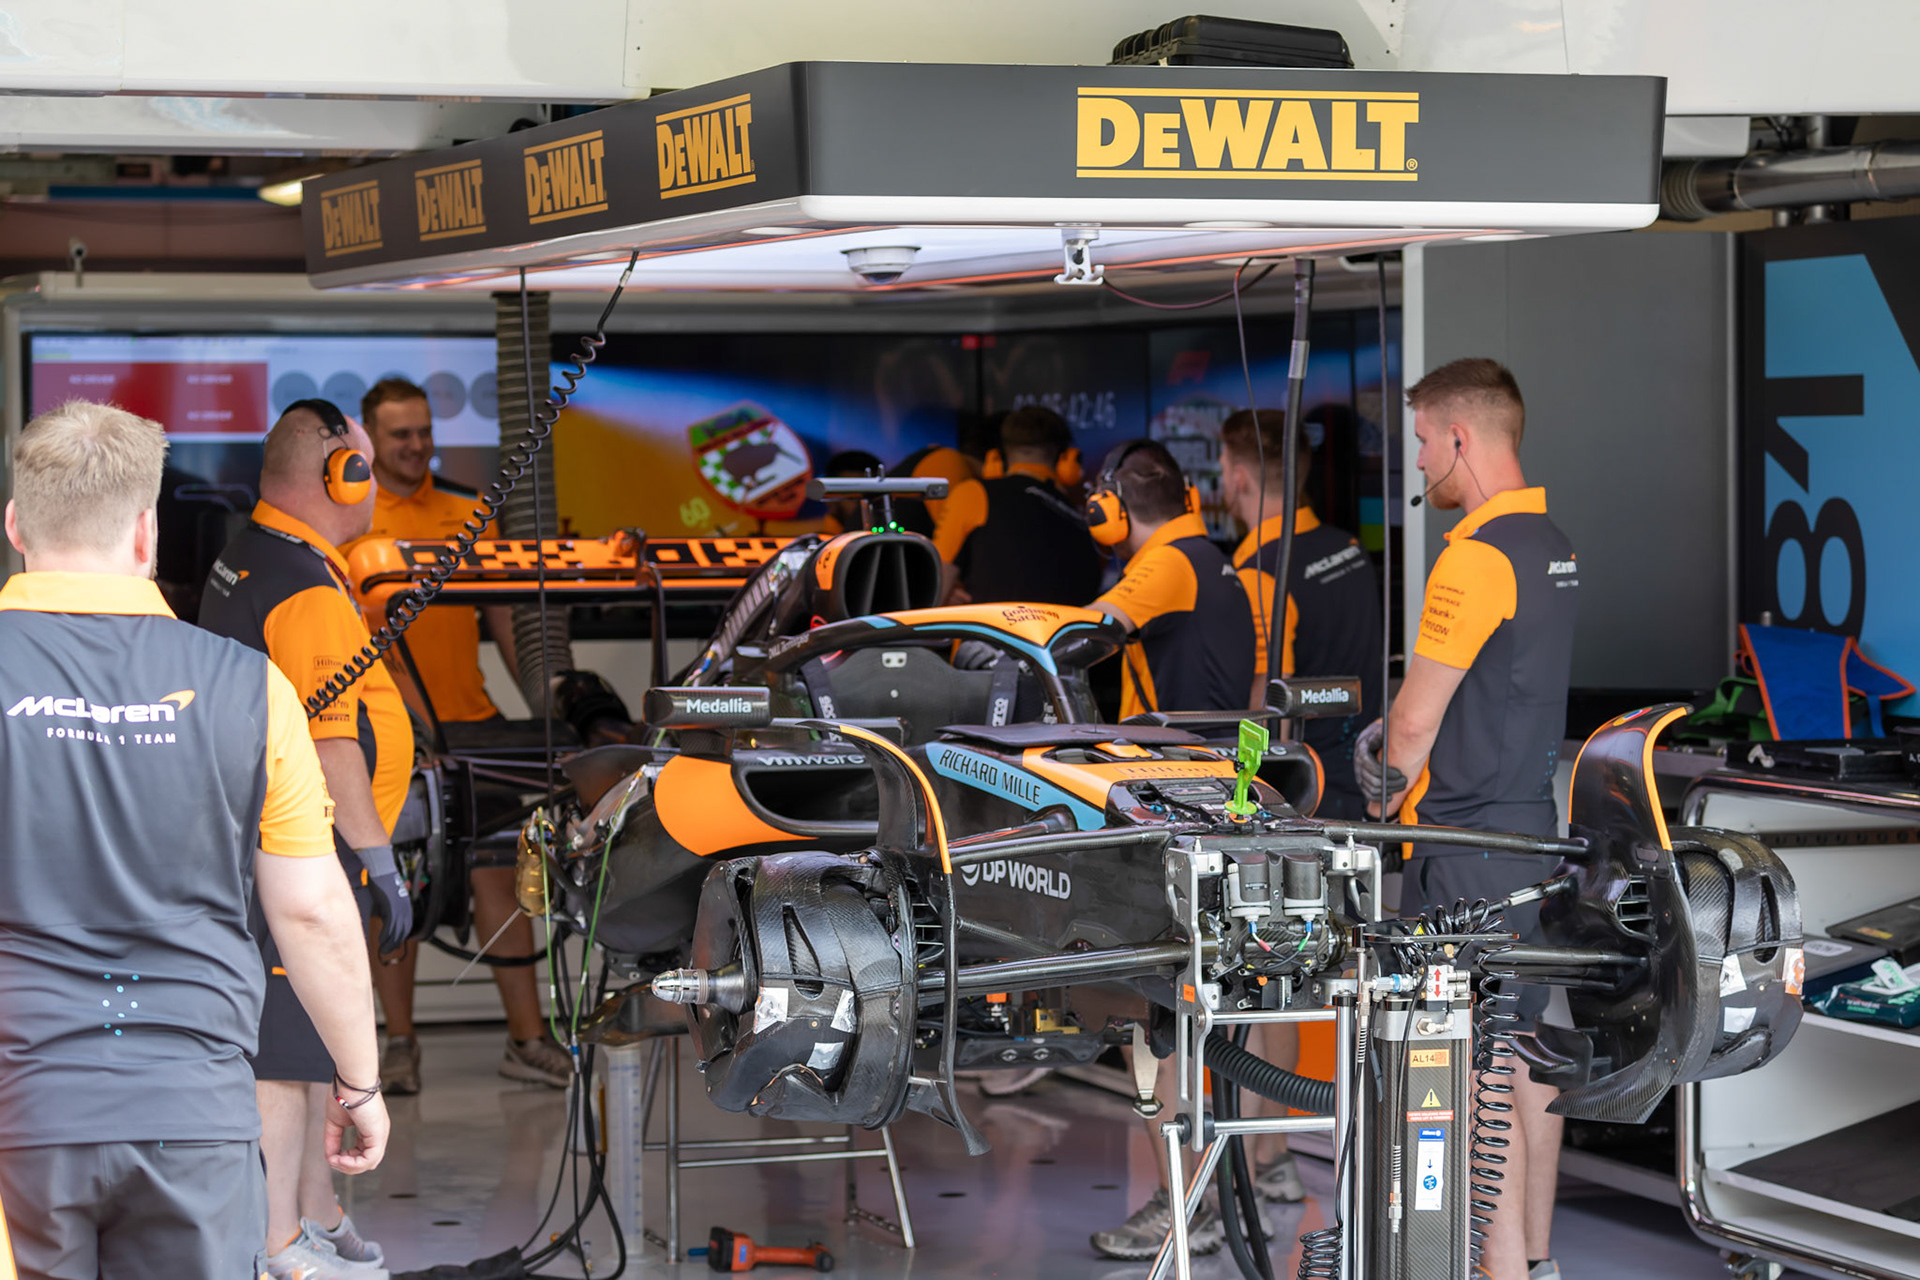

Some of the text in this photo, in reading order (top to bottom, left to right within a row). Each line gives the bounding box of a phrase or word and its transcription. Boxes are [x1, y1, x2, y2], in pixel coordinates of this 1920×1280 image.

[1301, 687, 1349, 704] Medallia
[6, 695, 176, 724] McLaren
[686, 698, 752, 713] Medallia
[46, 727, 177, 746] FORMULA 1 TEAM
[756, 754, 867, 766] vmware
[939, 749, 1041, 806] RICHARD MILLE
[1007, 860, 1071, 900] WORLD
[1412, 1054, 1435, 1063] AL14
